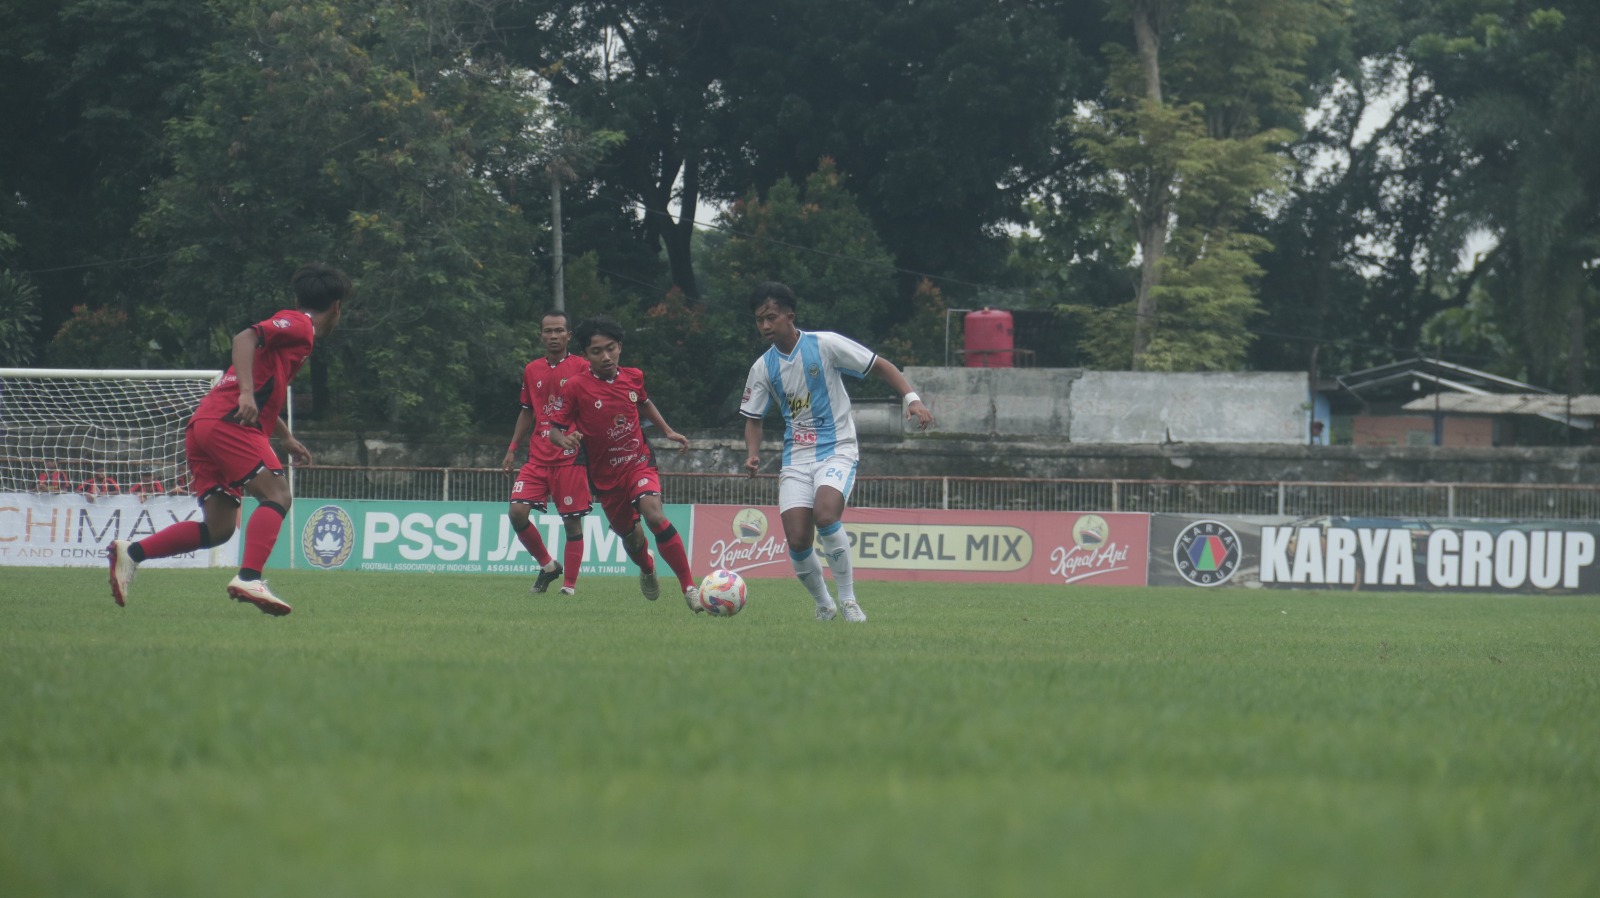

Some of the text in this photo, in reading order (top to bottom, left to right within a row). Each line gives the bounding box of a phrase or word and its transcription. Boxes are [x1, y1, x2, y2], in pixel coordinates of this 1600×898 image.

[825, 467, 843, 481] 24
[317, 523, 342, 534] PSSI
[362, 511, 483, 562] PSSI
[1181, 523, 1233, 544] KARYA
[17, 548, 54, 558] AND
[709, 535, 788, 570] Kapal Api
[965, 533, 1024, 562] MIX
[1259, 525, 1596, 589] KARYA GROUP
[361, 562, 482, 572] FOOTBALL ASSOCIATION OF INDONESIA
[486, 564, 528, 572] ASOSIASI
[597, 565, 627, 574] TIMUR
[1050, 542, 1130, 578] Kapal Api
[1178, 559, 1234, 584] GROUP
